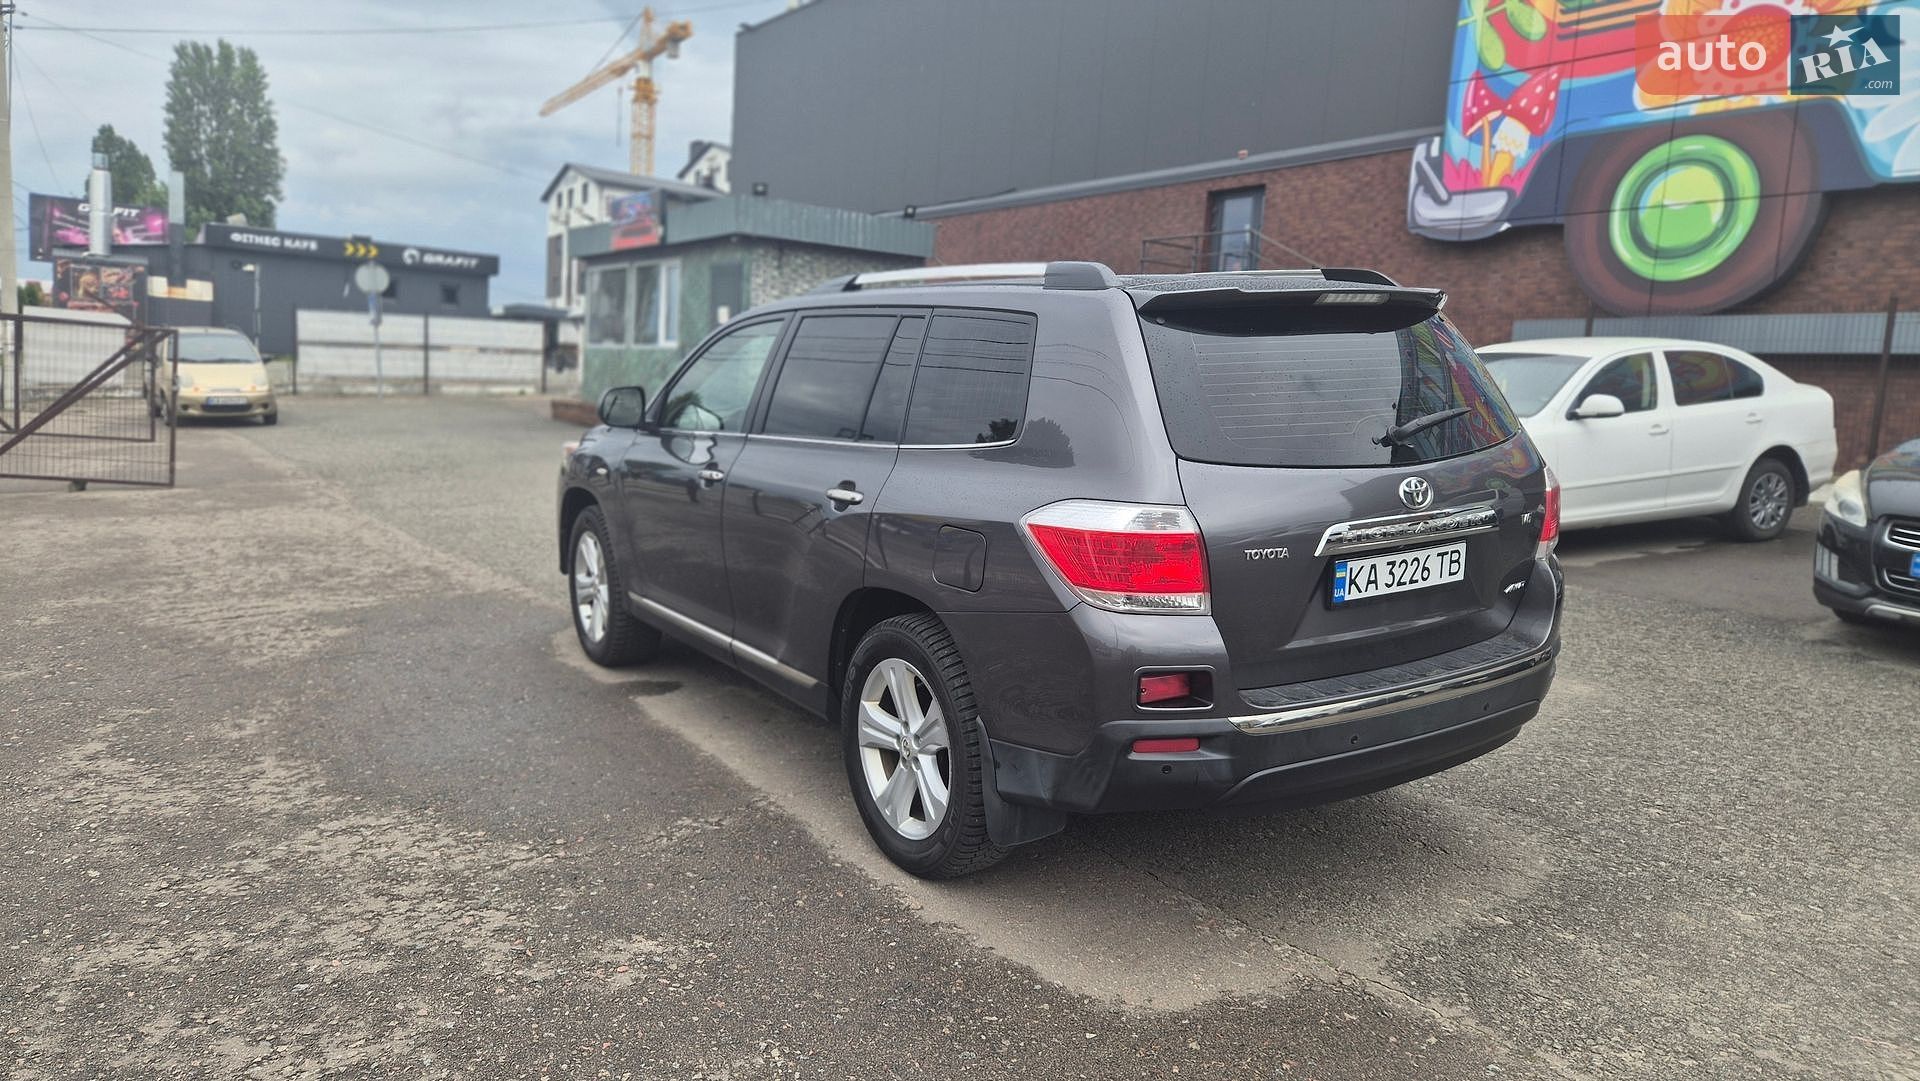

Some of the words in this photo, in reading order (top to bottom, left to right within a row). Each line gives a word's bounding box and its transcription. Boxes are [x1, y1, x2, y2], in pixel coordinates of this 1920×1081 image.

[1244, 547, 1289, 560] TOYOTA
[1348, 563, 1379, 595] KA
[1384, 554, 1431, 589] 3226
[1436, 549, 1461, 579] TB
[1334, 587, 1345, 598] UA
